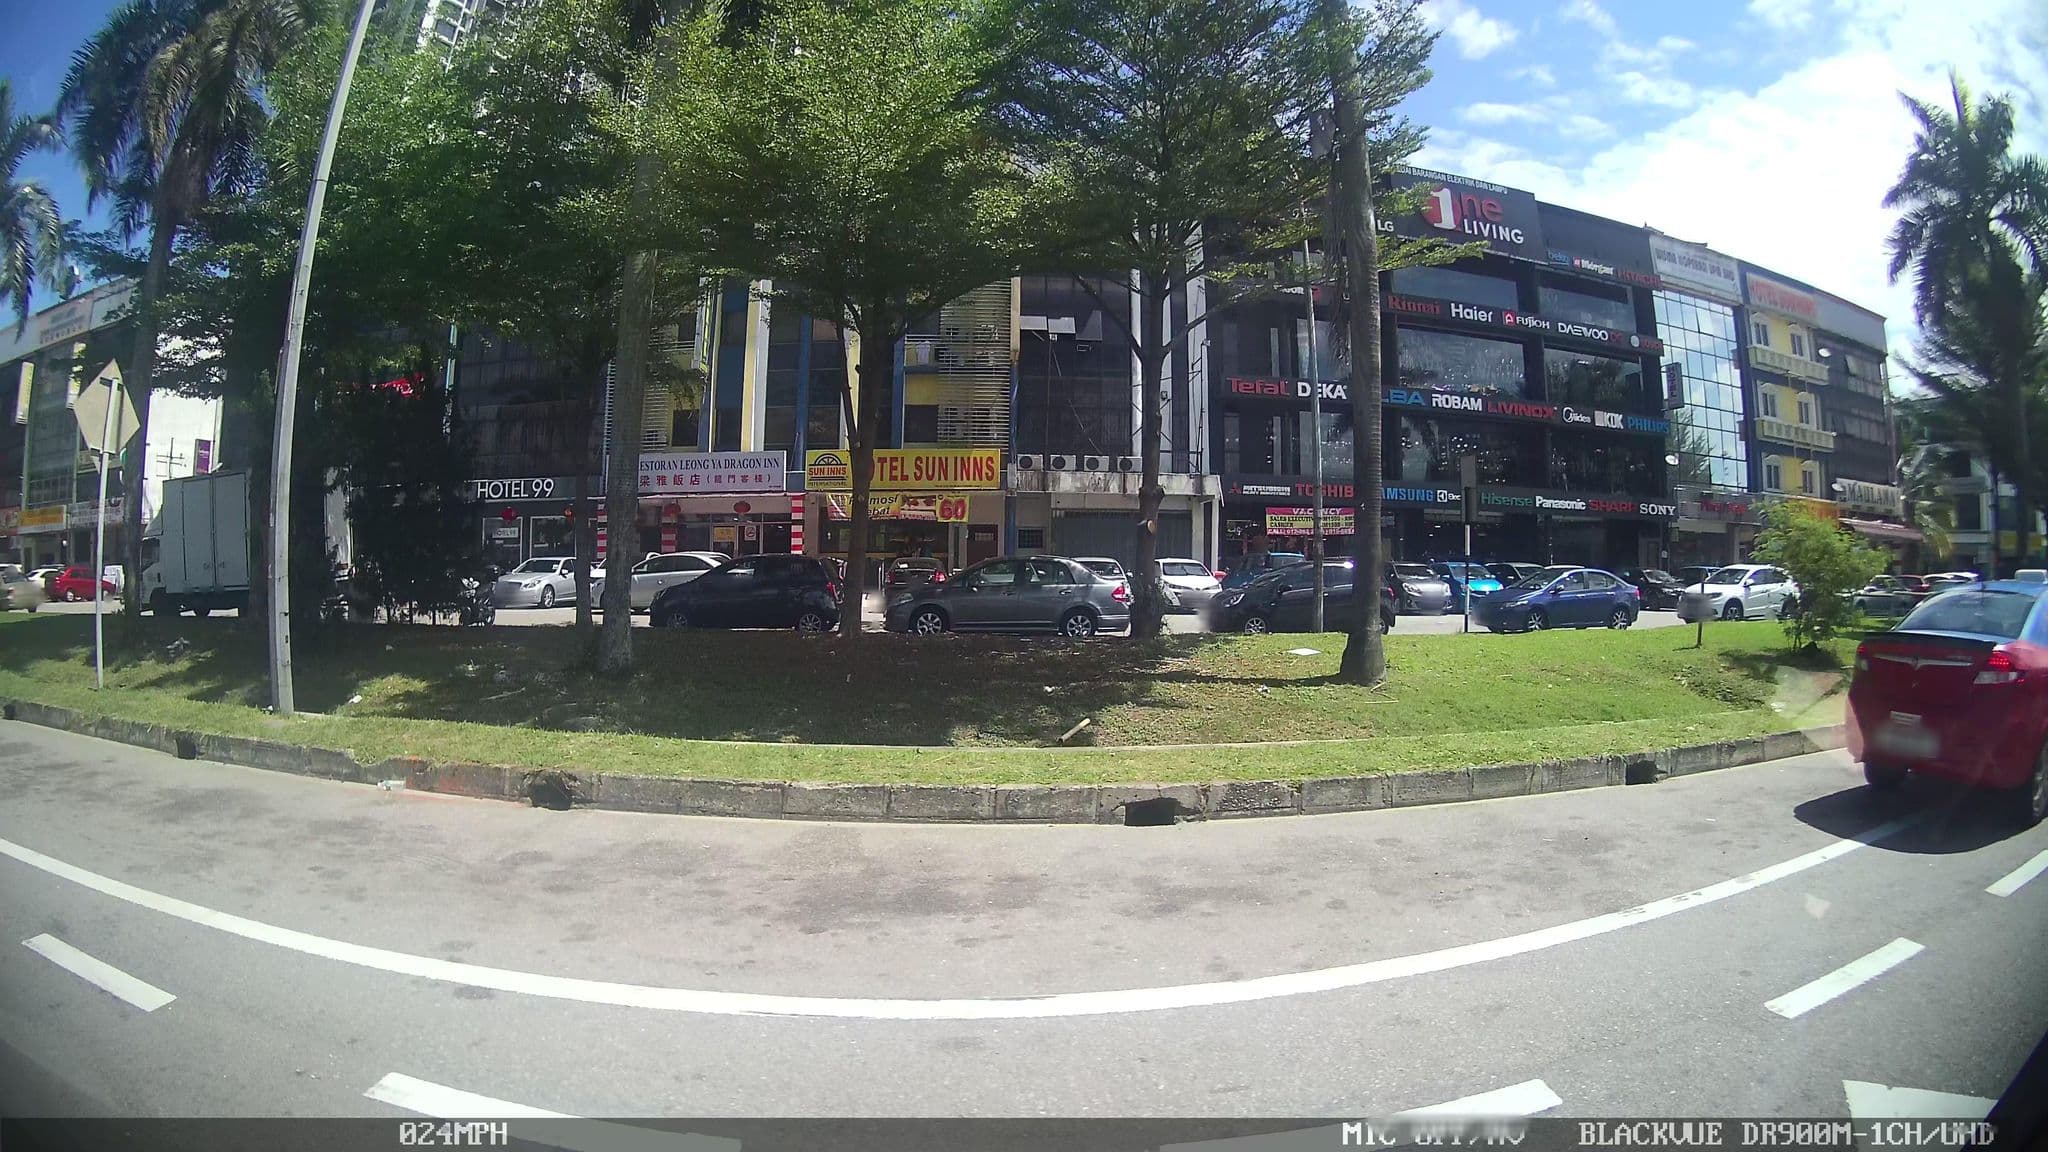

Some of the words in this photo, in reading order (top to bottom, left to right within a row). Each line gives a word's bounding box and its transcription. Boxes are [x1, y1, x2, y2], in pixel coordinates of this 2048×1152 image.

[1377, 219, 1394, 232] LG
[1463, 219, 1524, 245] LIVING
[1387, 295, 1440, 315] Rinnai
[1450, 303, 1493, 322] Haier
[1558, 322, 1609, 341] DAEWOO
[1226, 376, 1290, 396] Tefal
[1381, 388, 1426, 406] BA
[1431, 393, 1483, 412] ROBAM
[1488, 401, 1553, 418] LIVINOX
[1627, 415, 1670, 433] PHILIPS
[640, 460, 678, 472] ESTORAN
[680, 459, 709, 471] LEONG
[711, 459, 722, 470] YA
[724, 458, 761, 470] DRAGON
[764, 457, 780, 469] INN
[808, 467, 825, 476] SUN
[827, 466, 847, 476] INNS
[872, 456, 909, 482] TEL
[914, 456, 949, 482] SUN
[953, 456, 995, 482] INNS
[477, 480, 528, 498] HOTEL
[532, 479, 554, 498] 99
[1381, 487, 1434, 501] AMSUNG
[1481, 492, 1534, 507] Hisense
[1535, 496, 1586, 510] Panasonic
[1588, 500, 1636, 513] SHARP
[939, 498, 967, 520] 60
[1639, 503, 1677, 516] SONY
